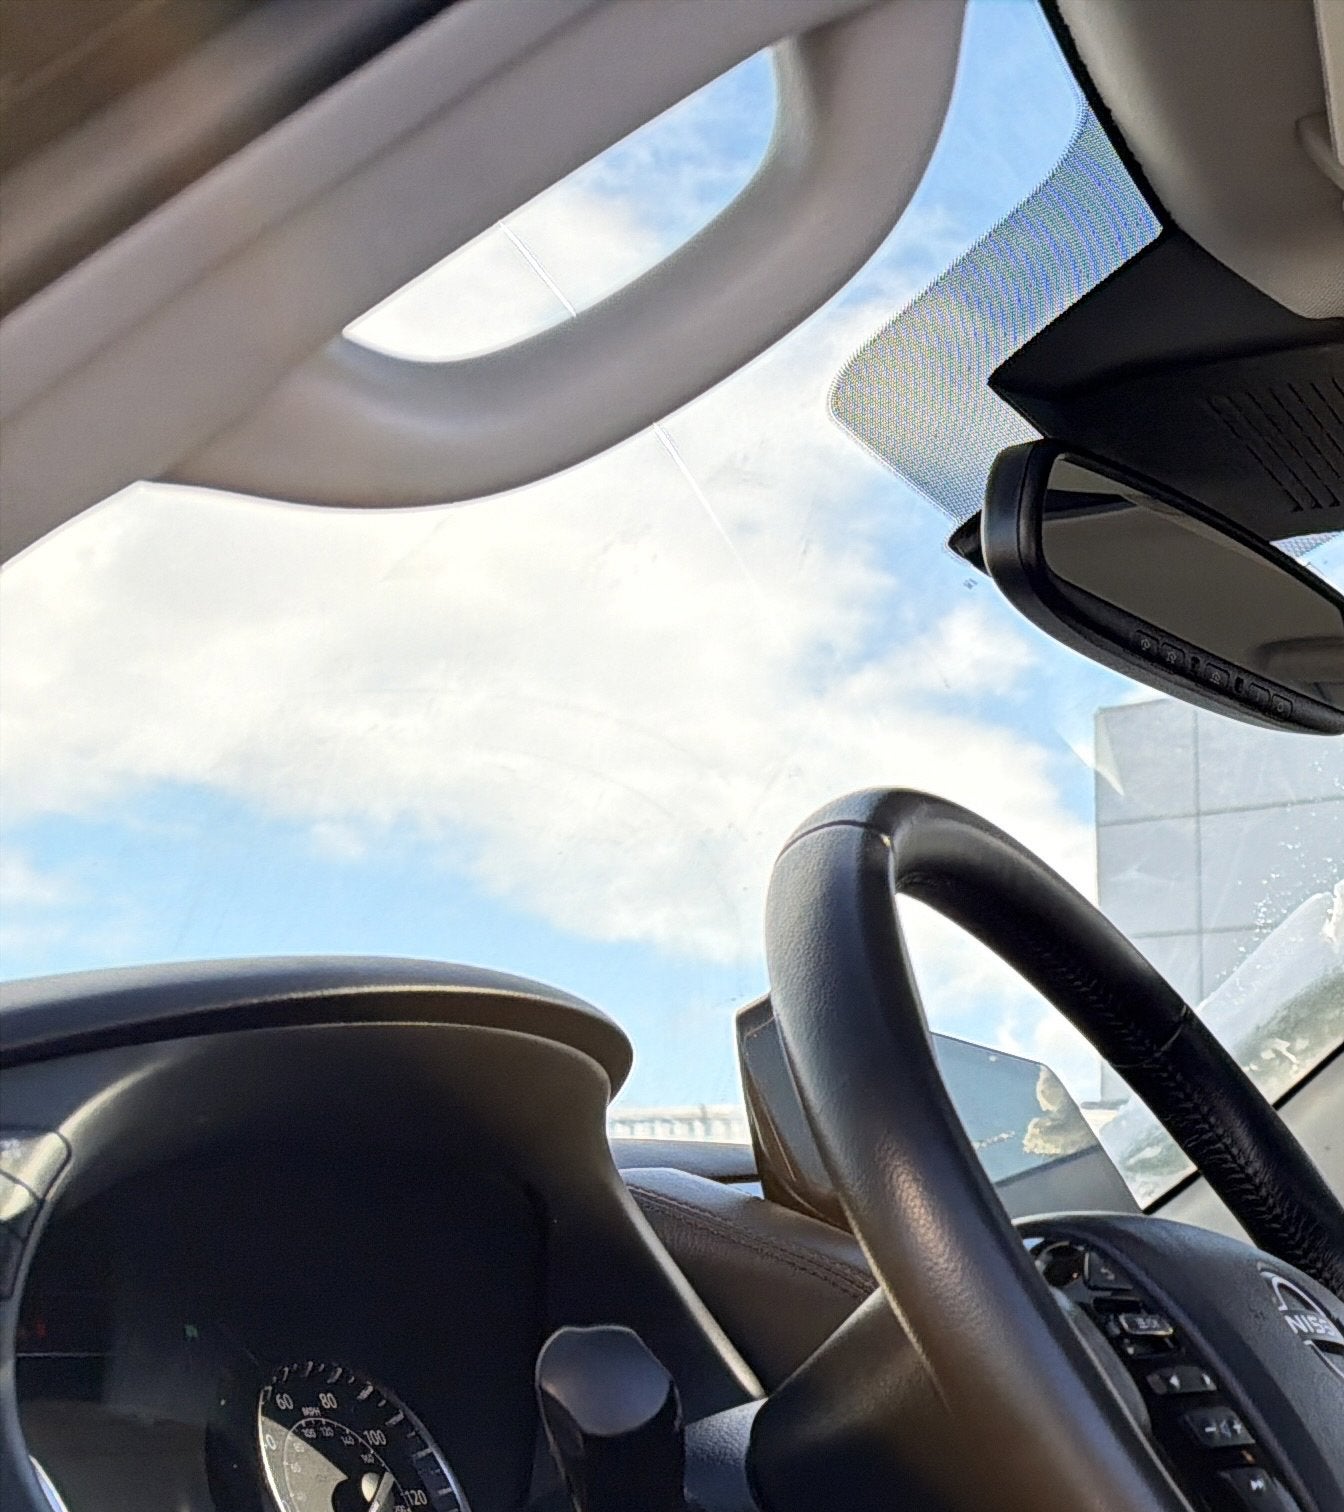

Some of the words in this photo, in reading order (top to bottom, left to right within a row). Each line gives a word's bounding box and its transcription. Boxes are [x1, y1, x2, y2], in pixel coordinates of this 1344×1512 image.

[275, 1393, 293, 1410] 60
[319, 1392, 337, 1409] 80
[363, 1429, 387, 1446] 100
[404, 1489, 428, 1506] 120
